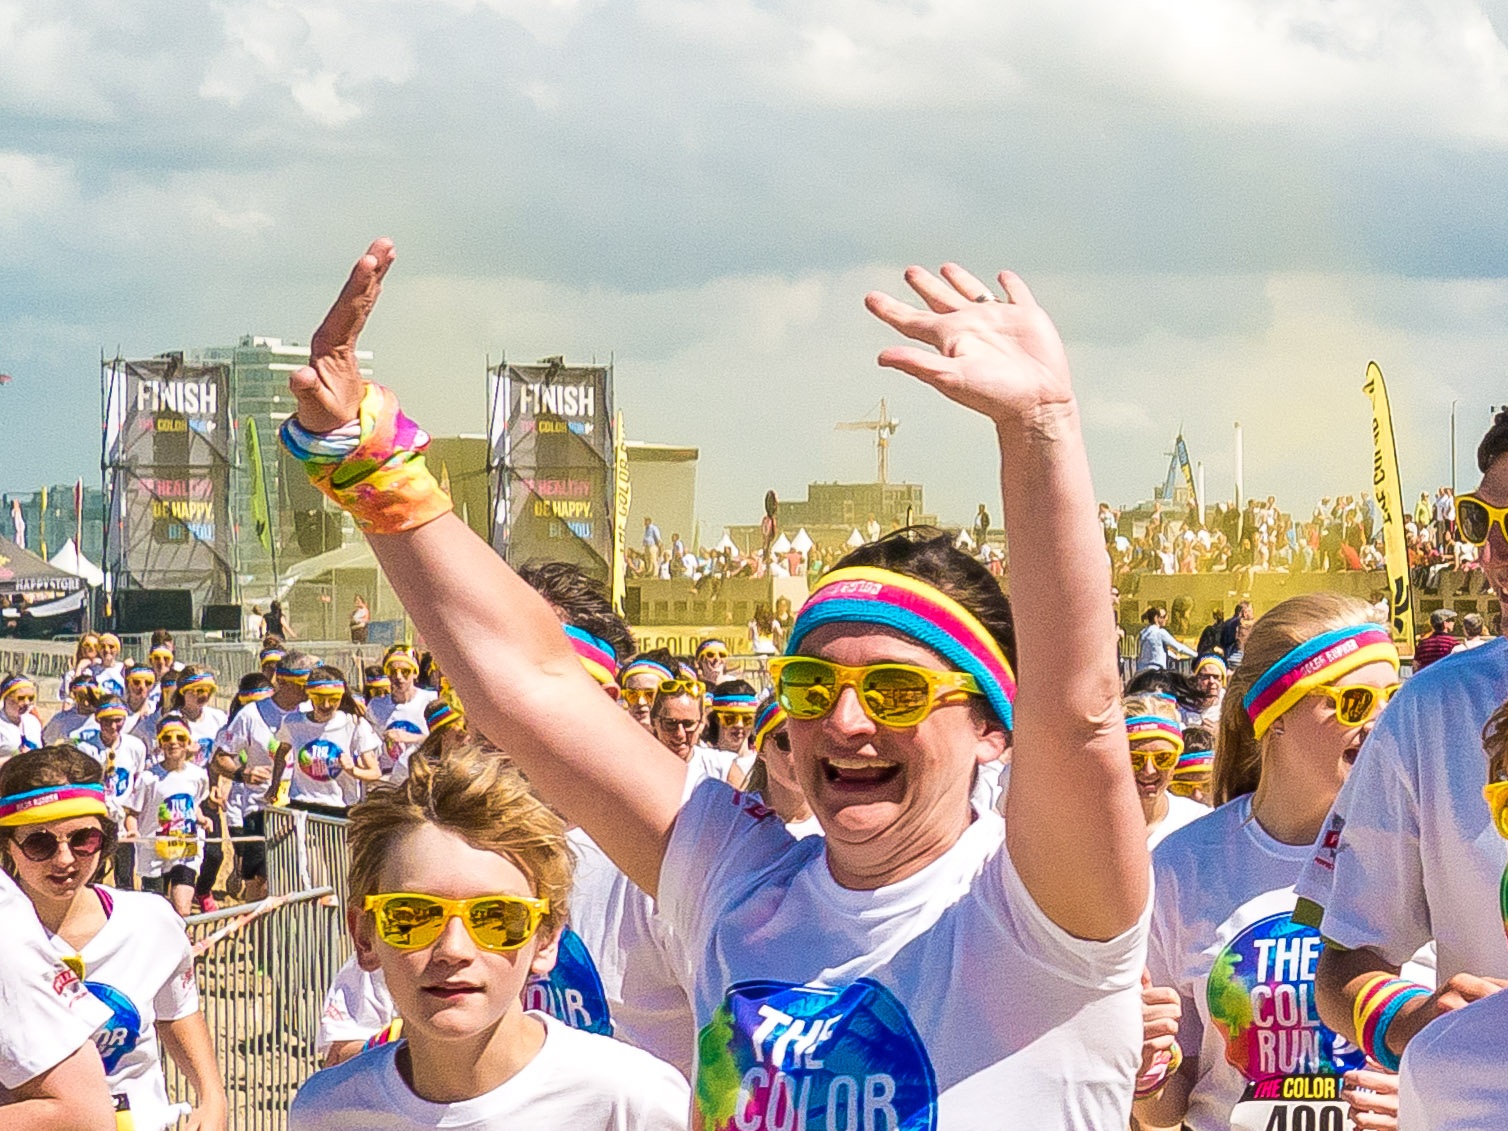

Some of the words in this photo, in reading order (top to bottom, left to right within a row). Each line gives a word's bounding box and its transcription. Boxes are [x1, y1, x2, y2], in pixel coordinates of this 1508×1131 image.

[136, 380, 217, 414] FINISH
[519, 385, 595, 417] FINISH
[157, 418, 188, 433] COLOR
[538, 421, 567, 434] COLOR
[157, 480, 214, 497] HEALTHY
[537, 479, 591, 497] HEALTHY
[1253, 936, 1321, 983] THE
[1251, 983, 1321, 1028] COL
[751, 1003, 844, 1071] THE
[1257, 1028, 1321, 1075] RUN
[1253, 1078, 1283, 1100] THE
[1283, 1076, 1336, 1099] COLOR
